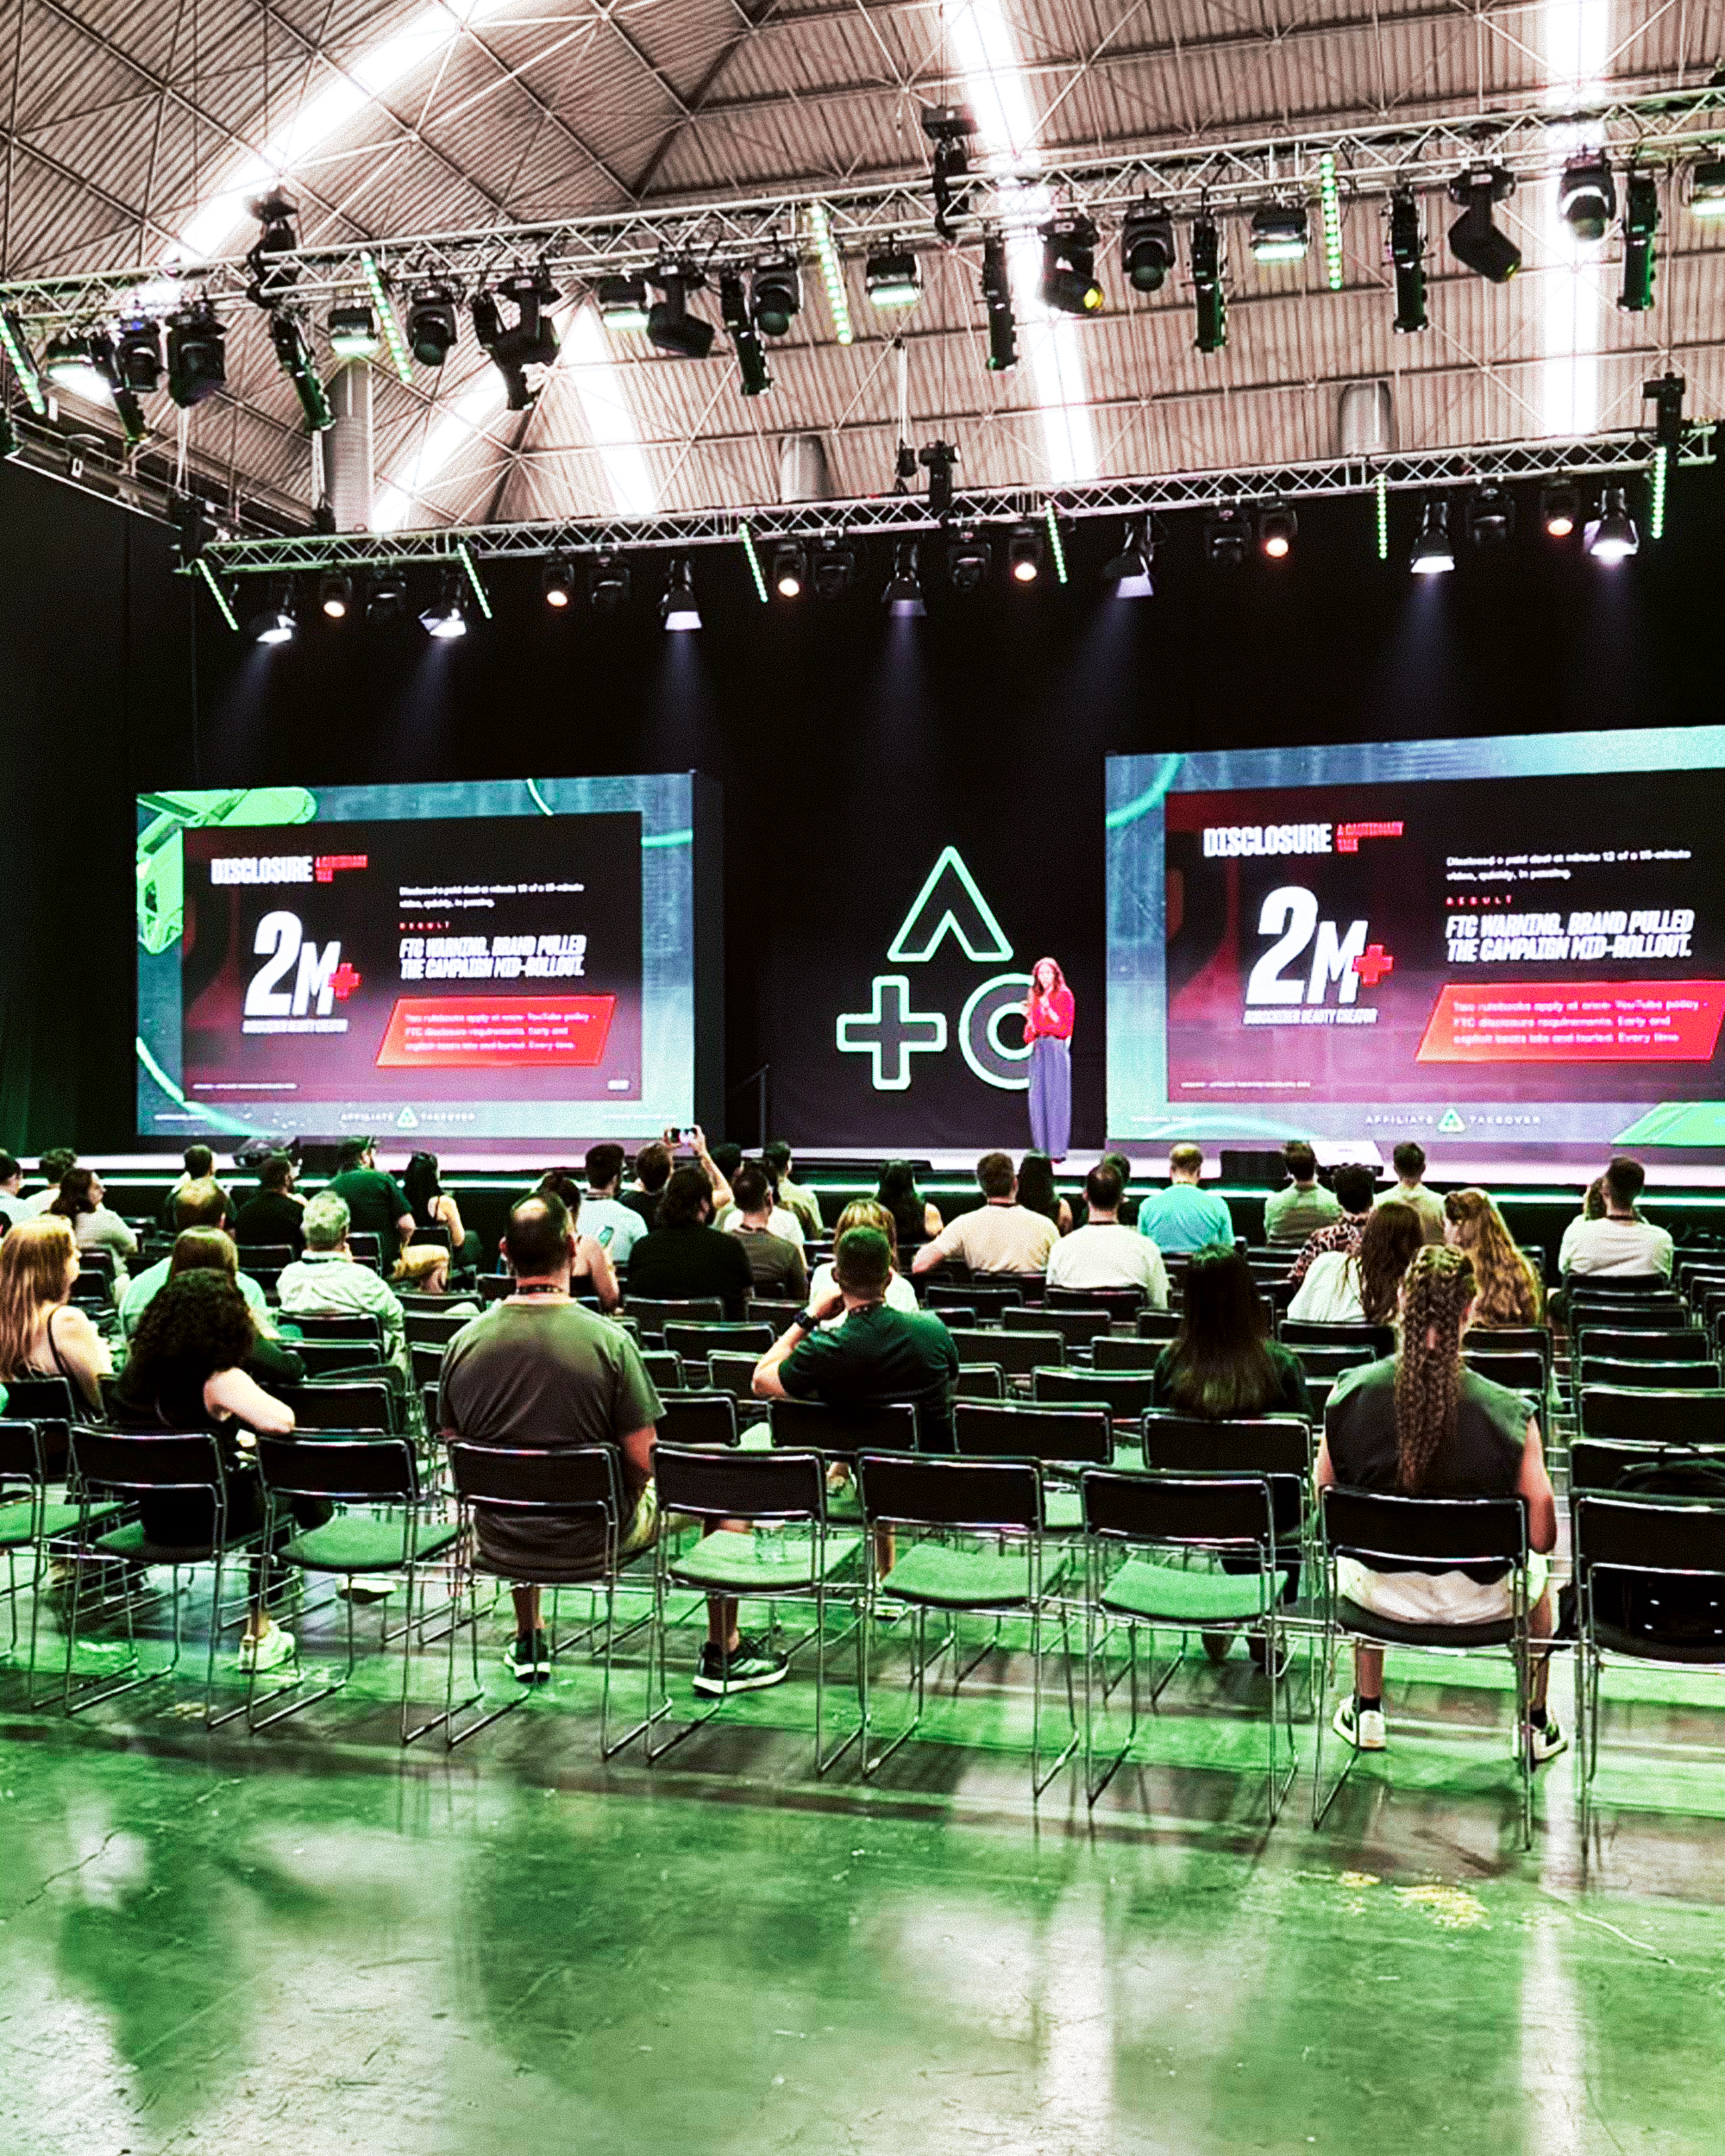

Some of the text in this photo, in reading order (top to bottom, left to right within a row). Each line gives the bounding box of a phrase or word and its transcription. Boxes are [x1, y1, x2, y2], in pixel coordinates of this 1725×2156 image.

[1203, 823, 1332, 857] DISCLOSURE
[210, 856, 313, 884] DISCLOSURE
[1446, 915, 1478, 937] FTC
[1567, 911, 1628, 936] BRAND
[1628, 909, 1695, 934] PULLED
[1447, 938, 1479, 962] THE
[1479, 937, 1570, 961] CAMPAIGN
[1365, 1115, 1541, 1125] AFFILIATE TAKEOVER
